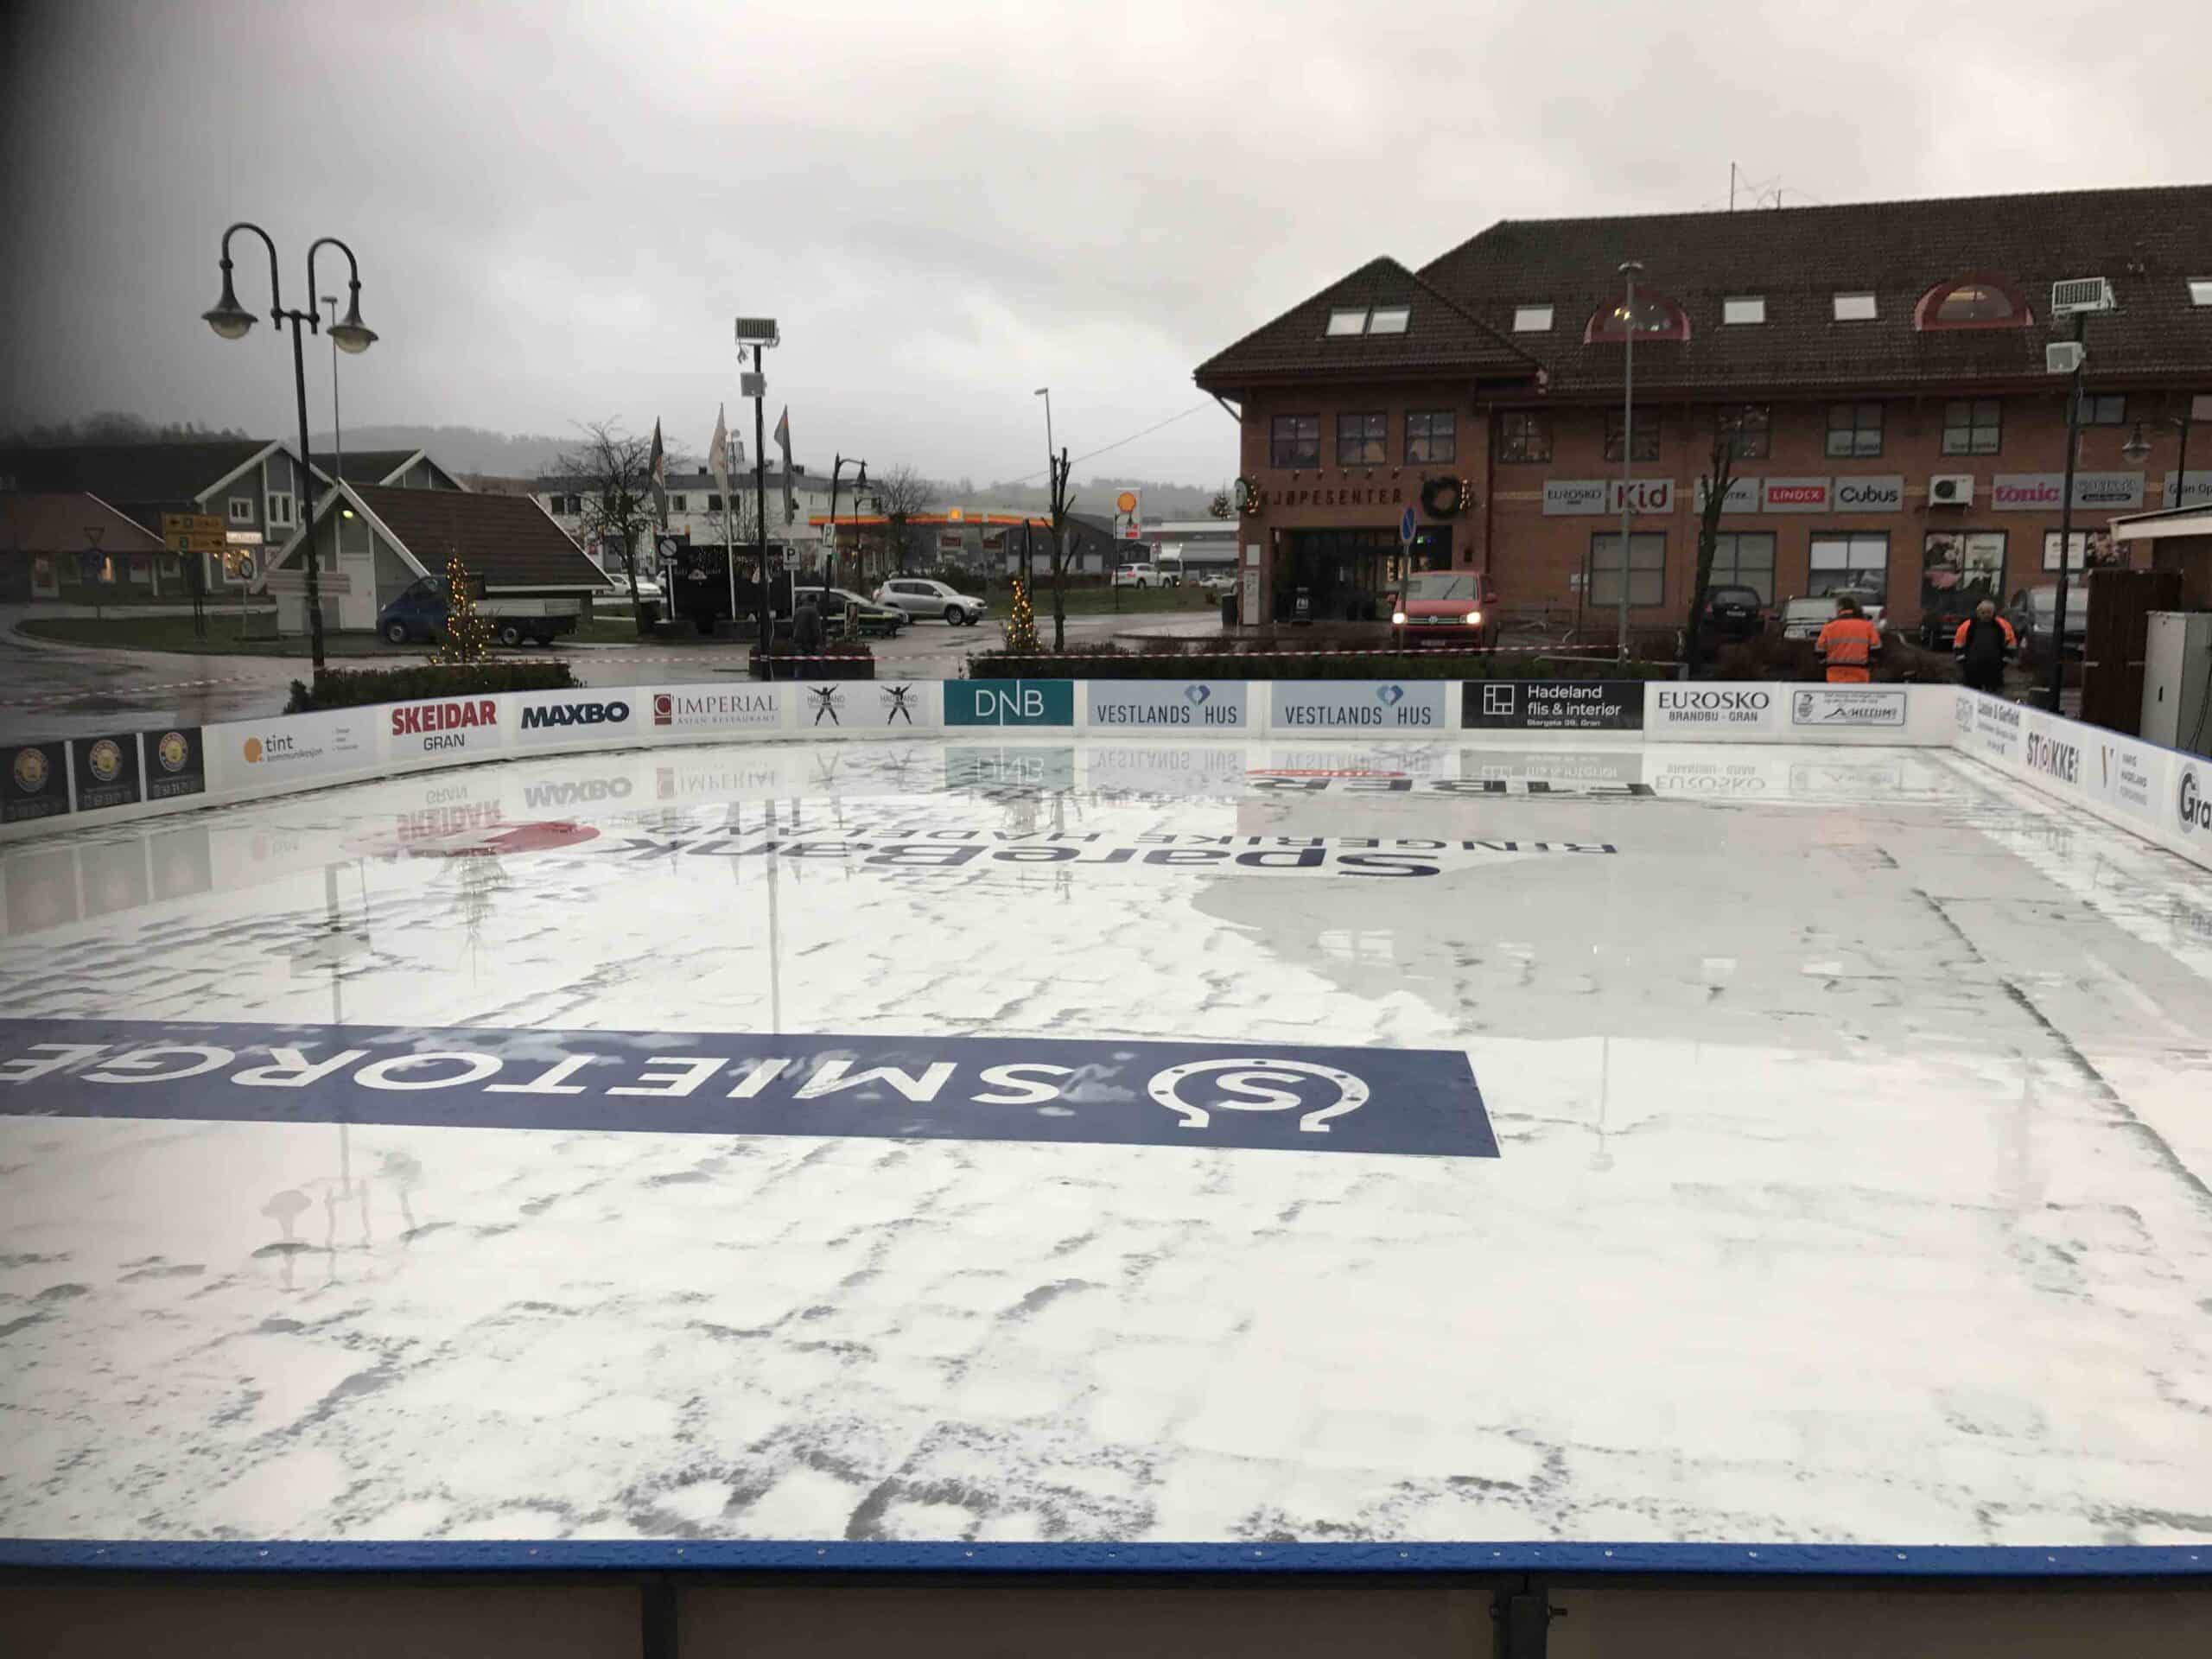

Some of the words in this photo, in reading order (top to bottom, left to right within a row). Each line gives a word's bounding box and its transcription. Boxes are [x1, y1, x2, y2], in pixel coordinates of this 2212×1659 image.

[1548, 488, 1602, 499] EUROSKO
[1618, 483, 1668, 509] Kid
[1771, 487, 1820, 500] LINDEX
[1840, 485, 1898, 503] Cubus
[1995, 482, 2061, 503] tonic
[2169, 483, 2196, 494] Gan
[786, 548, 796, 561] P
[1528, 684, 1602, 699] Hadeland
[1659, 691, 1770, 709] EUROSKO
[678, 696, 778, 715] IMPERIAL
[975, 680, 1044, 724] DNB
[1528, 702, 1549, 715] flis
[1552, 702, 1563, 715] &
[1567, 701, 1622, 716] interiør
[392, 700, 497, 735] SKEIDAR
[521, 701, 629, 729] MAXBO
[1097, 704, 1190, 724] VESTLANDS
[1205, 704, 1237, 724] HUS
[1286, 704, 1382, 725] VESTLANDS
[1397, 705, 1431, 725] HUS
[1669, 711, 1719, 722] BRANDBU
[1728, 711, 1758, 722] GRAN
[266, 734, 294, 753] tint
[423, 734, 465, 751] GRAN
[592, 838, 1441, 878] SpareBank
